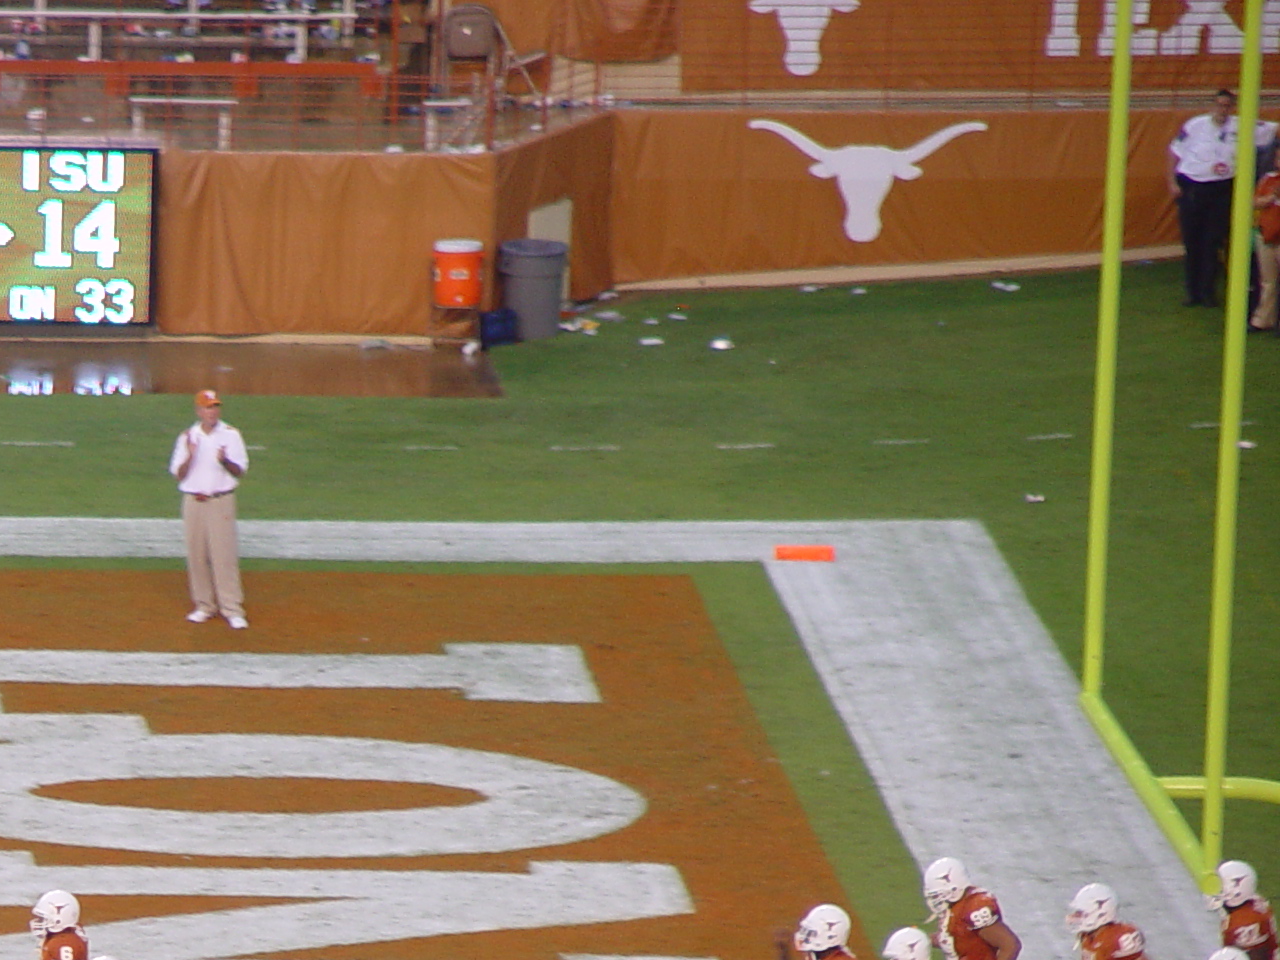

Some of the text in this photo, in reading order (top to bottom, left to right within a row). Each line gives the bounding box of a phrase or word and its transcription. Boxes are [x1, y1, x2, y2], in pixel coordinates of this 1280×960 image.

[22, 151, 124, 192] ISU
[34, 200, 120, 268] 14
[9, 286, 56, 320] ON
[74, 279, 135, 323] 33
